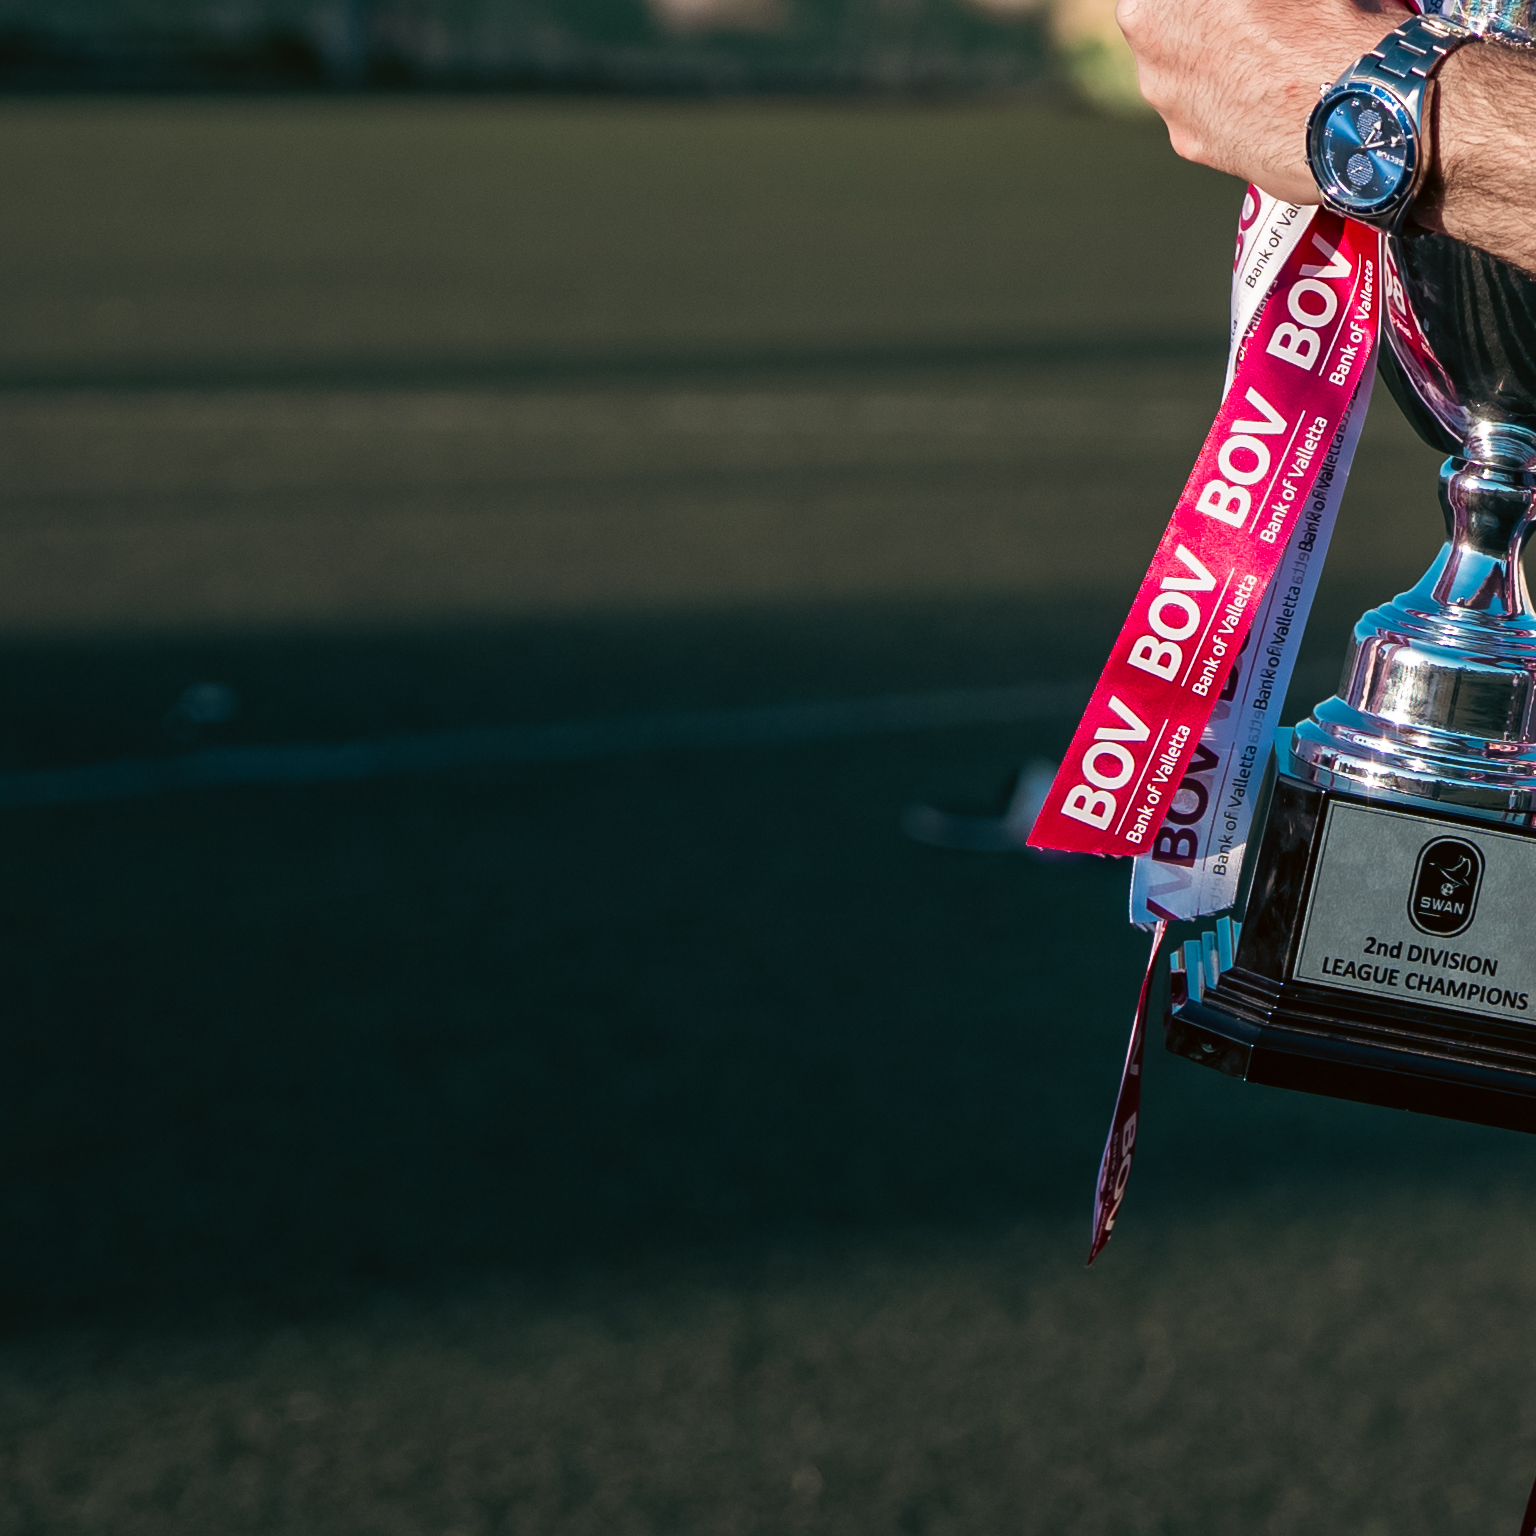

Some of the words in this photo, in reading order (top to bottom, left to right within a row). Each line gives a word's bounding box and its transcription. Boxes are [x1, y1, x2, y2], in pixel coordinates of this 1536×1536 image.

[1245, 247, 1273, 289] Bank
[1268, 226, 1283, 249] of
[1265, 232, 1353, 372] BOV
[1354, 260, 1374, 321] Valletta
[1350, 320, 1365, 344] of
[1329, 344, 1358, 387] Bank
[1195, 386, 1288, 529] BOV
[1289, 416, 1328, 478] Valletta
[1283, 479, 1298, 502] of
[1260, 501, 1292, 545] Bank
[1127, 544, 1217, 682] BOV
[1218, 574, 1258, 634] Valletta
[1271, 584, 1301, 649] Valletta
[1212, 630, 1228, 656] of
[1264, 647, 1281, 668] of
[1192, 654, 1221, 697] Bank
[1252, 666, 1276, 711] Bank
[1061, 695, 1151, 831] BOV
[1152, 725, 1191, 783] Valletta
[1146, 781, 1162, 806] of
[1228, 745, 1257, 809] Valletta
[1126, 804, 1154, 844] Bank
[1223, 809, 1237, 832] of
[1213, 833, 1235, 877] Bank
[1420, 896, 1465, 915] SWAN
[1363, 936, 1403, 960] 2nd
[1407, 944, 1498, 977] DIVISION
[1321, 956, 1400, 987] LEAGUE
[1404, 972, 1529, 1011] CHAMPIONS
